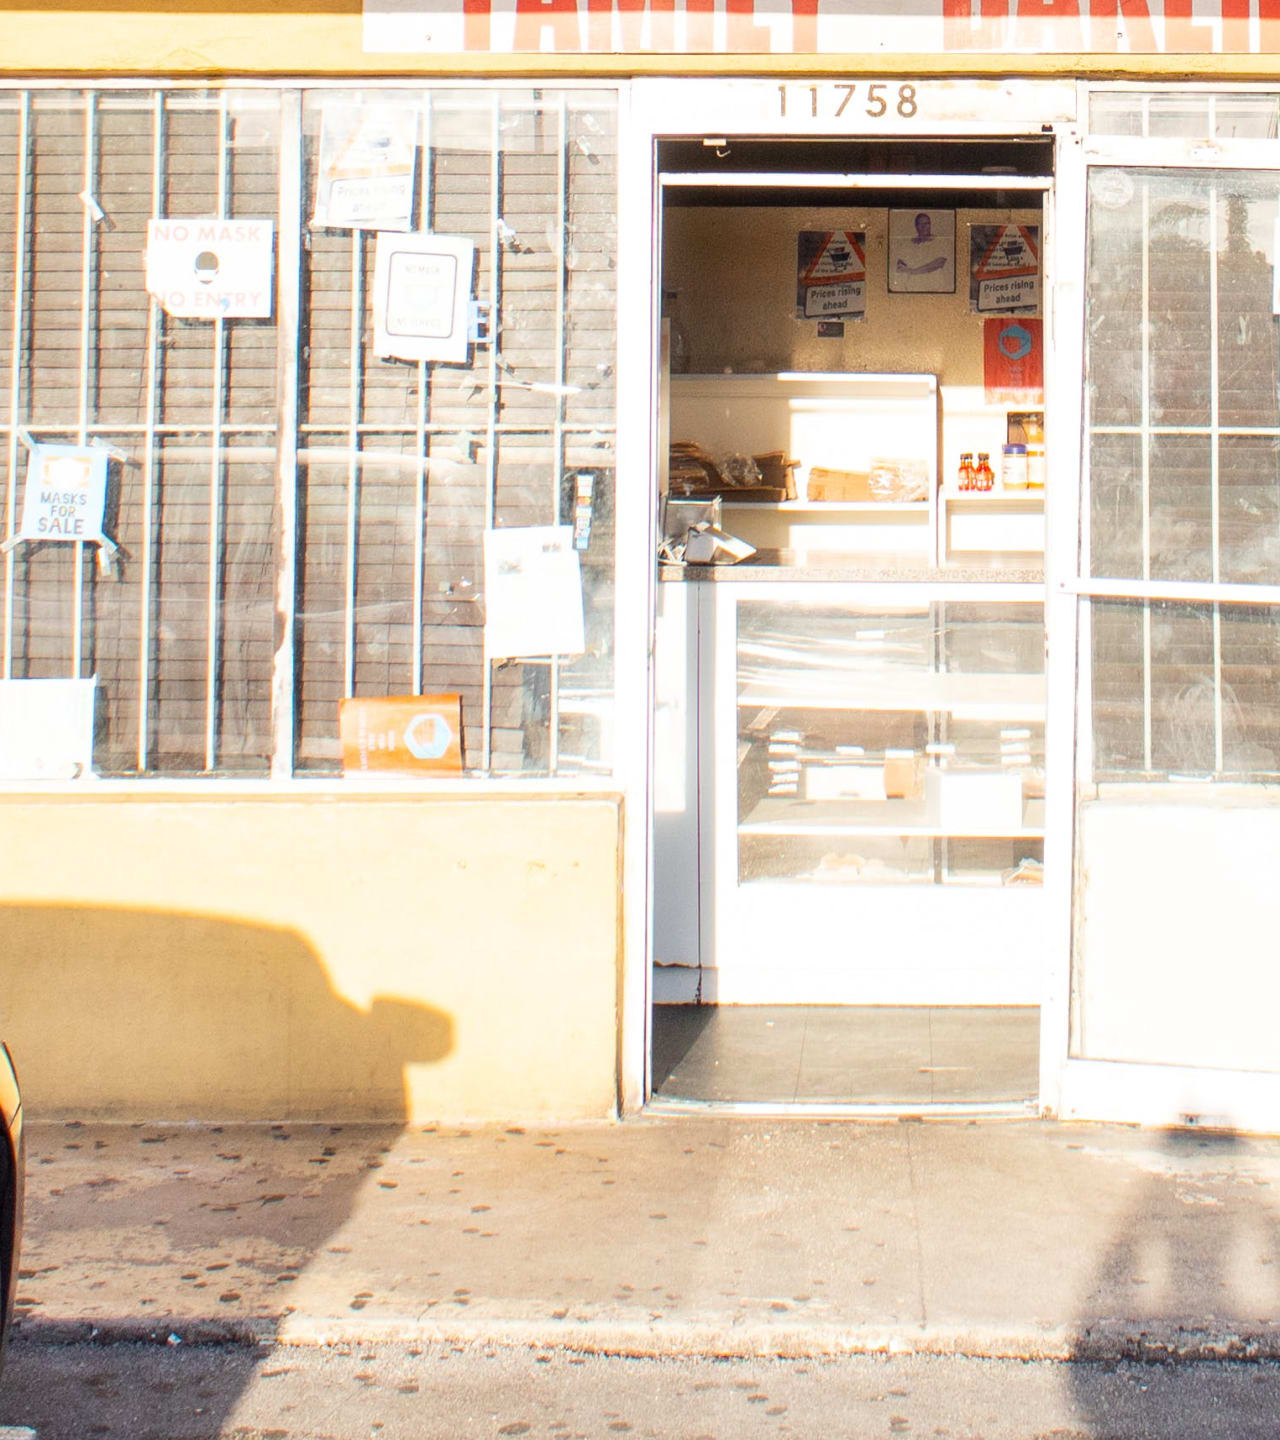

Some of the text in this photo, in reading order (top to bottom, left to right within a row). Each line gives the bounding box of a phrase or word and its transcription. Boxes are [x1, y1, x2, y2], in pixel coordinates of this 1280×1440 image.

[778, 84, 917, 118] 11758
[154, 225, 261, 242] NO MASK
[194, 291, 262, 308] ENTRY
[40, 491, 88, 506] MASKS
[51, 505, 76, 518] FOR
[38, 517, 84, 535] SALE
